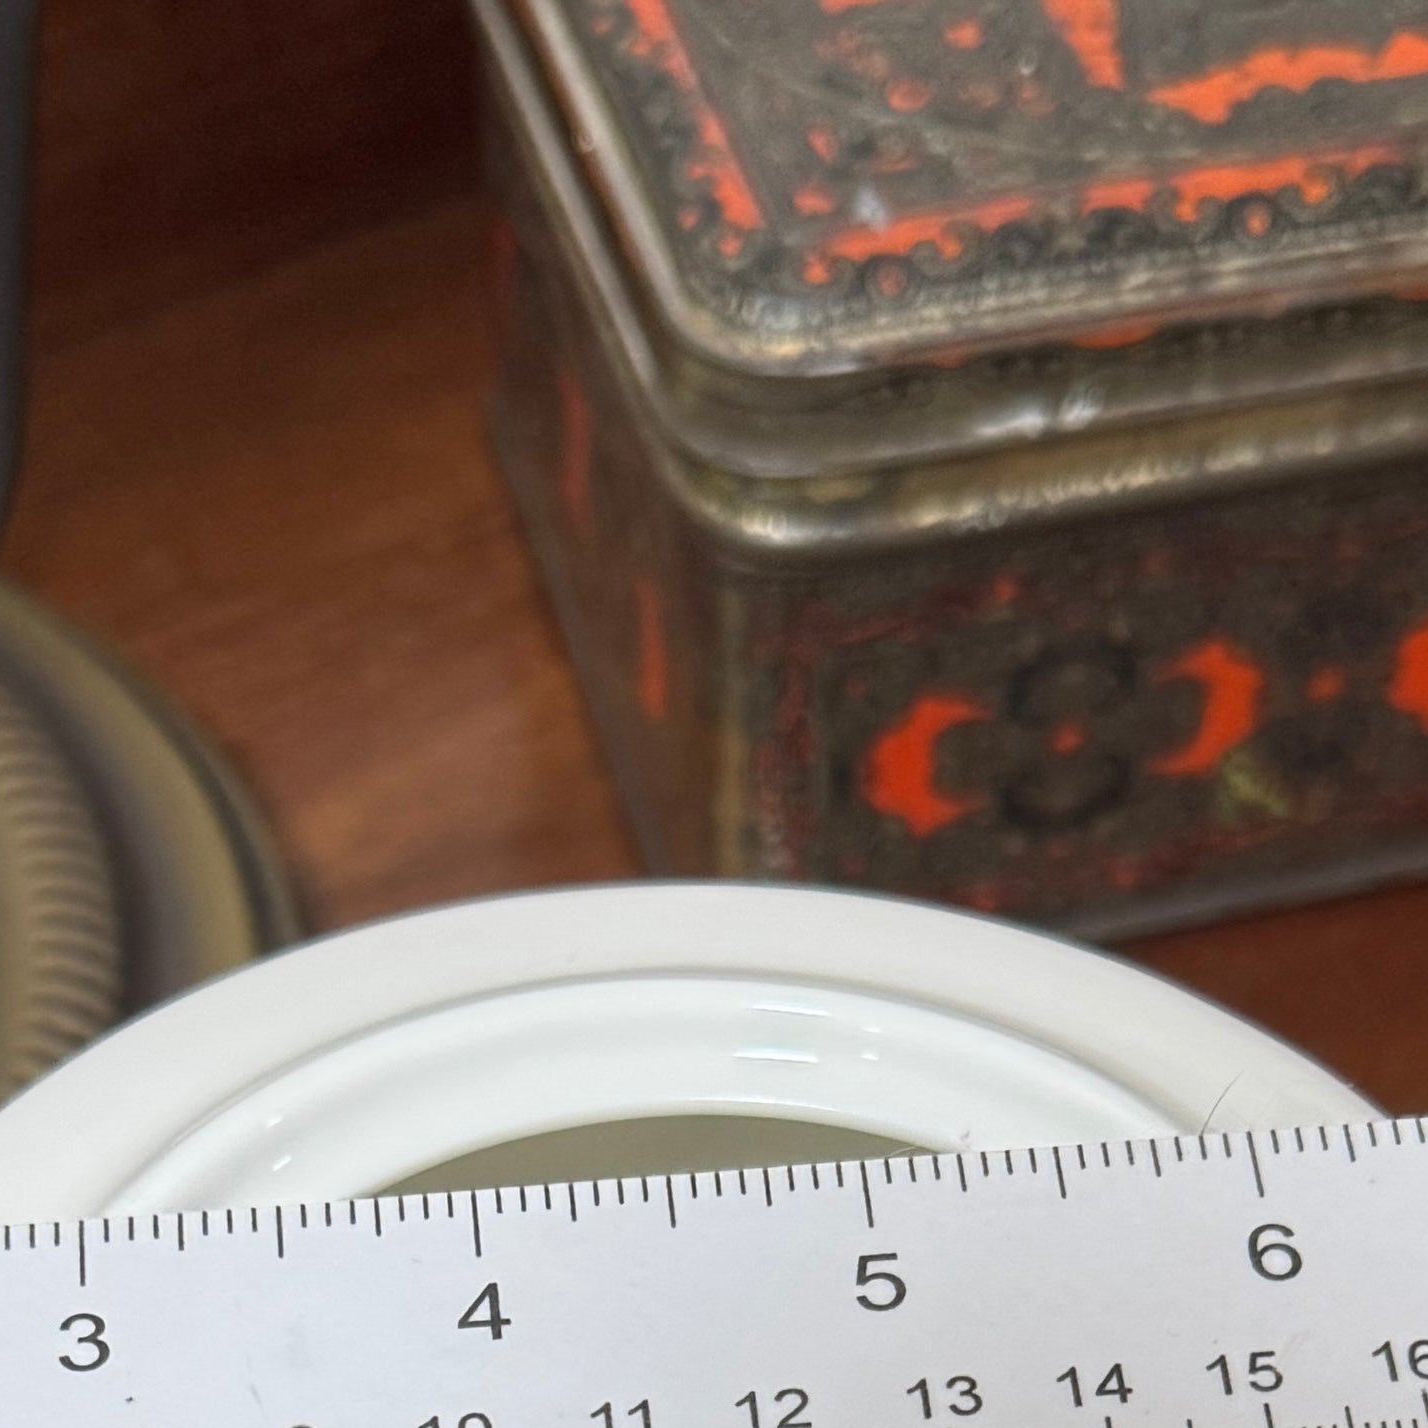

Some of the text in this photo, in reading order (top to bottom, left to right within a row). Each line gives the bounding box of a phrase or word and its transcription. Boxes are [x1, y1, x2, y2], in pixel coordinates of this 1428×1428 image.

[58, 1312, 111, 1373] 3
[457, 1281, 512, 1341] 4
[855, 1252, 907, 1312] 5
[1247, 1223, 1303, 1282] 6
[906, 1375, 984, 1420] 13
[1055, 1362, 1134, 1408] 14
[1205, 1350, 1284, 1396] 15
